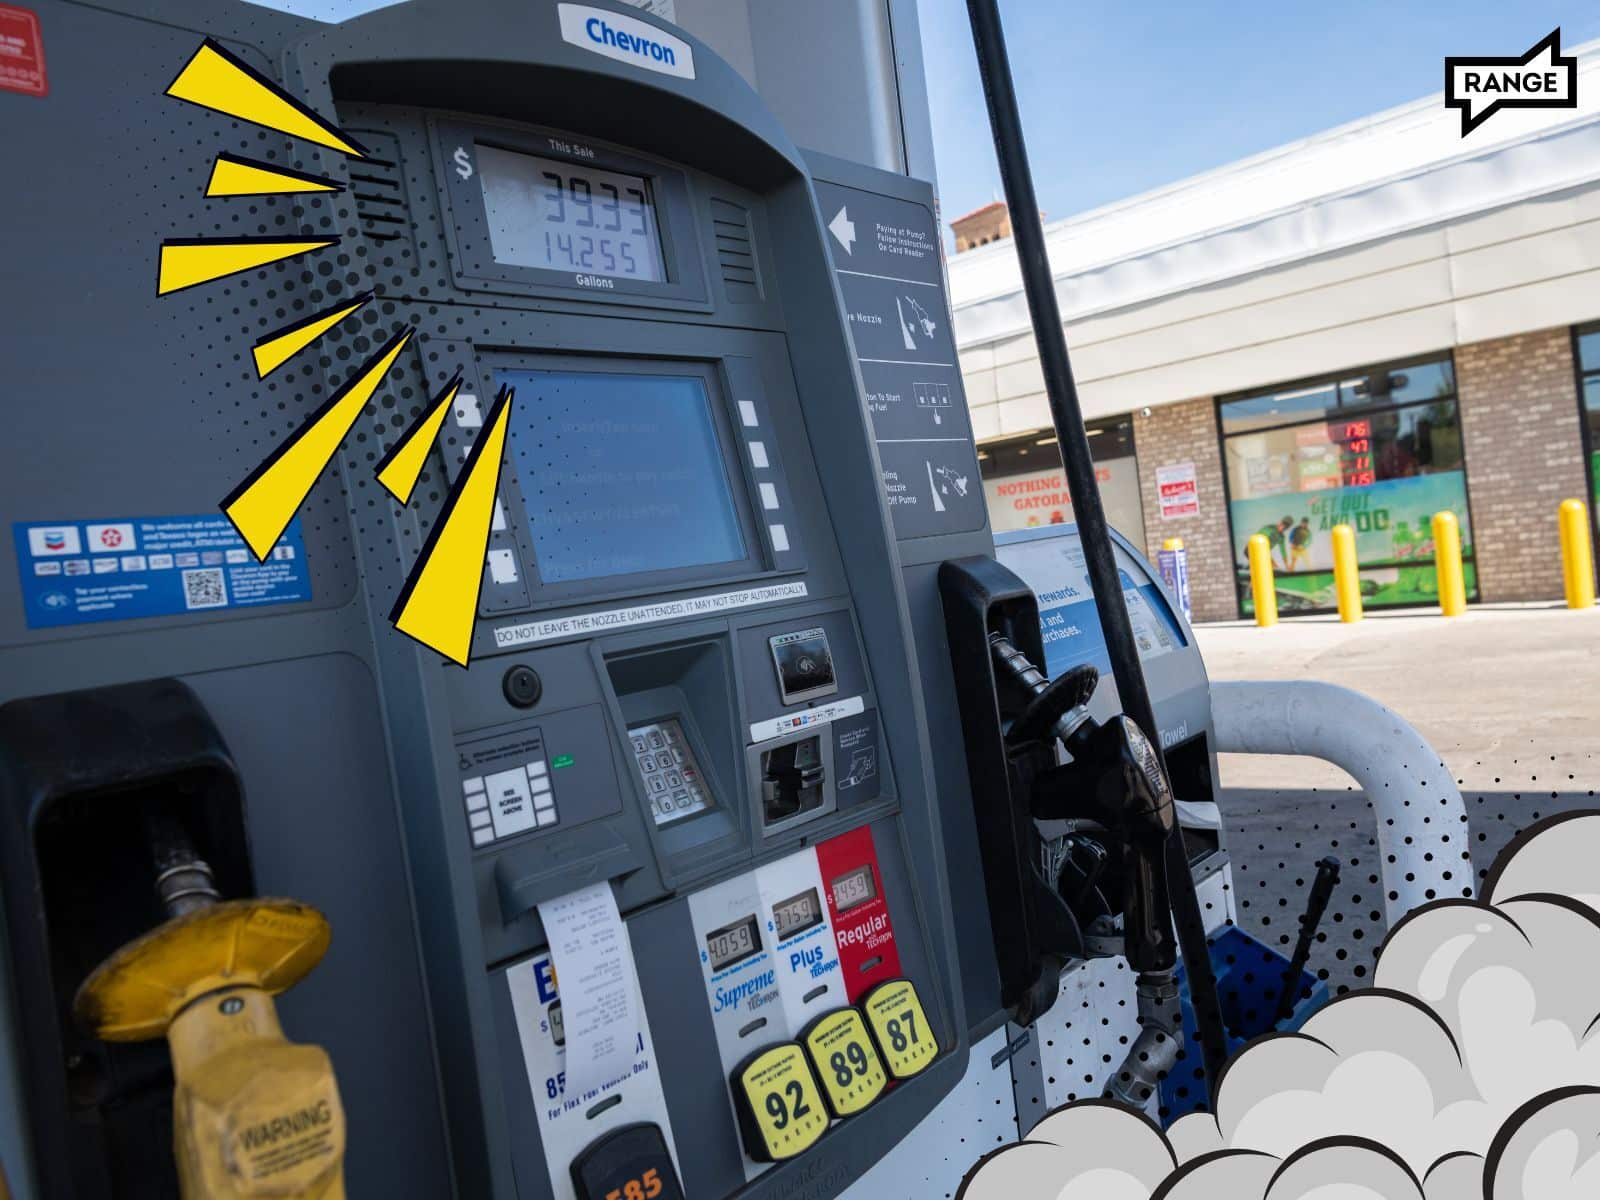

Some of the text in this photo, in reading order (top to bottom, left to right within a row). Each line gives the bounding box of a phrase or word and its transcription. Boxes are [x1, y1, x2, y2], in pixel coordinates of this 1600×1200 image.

[586, 18, 676, 66] Chevron
[454, 147, 473, 180] $
[549, 139, 596, 159] This Sale
[542, 171, 647, 236] 39.33
[544, 231, 636, 274] 14.255
[576, 274, 614, 289] Gallons
[996, 476, 1061, 496] NOTHING
[1014, 492, 1072, 510] GATORA
[1038, 586, 1080, 604] rewards.
[496, 630, 514, 642] DO
[514, 626, 536, 640] NOT
[538, 622, 570, 636] LEAVE
[571, 618, 590, 630] THE
[591, 612, 627, 628] NOZZLE
[686, 602, 694, 611] IT
[694, 599, 714, 610] MAY
[714, 597, 728, 607] NOT
[730, 593, 749, 604] STOP
[750, 585, 806, 600] AUTOMATICALLY
[1047, 612, 1064, 626] and
[1159, 720, 1188, 746] Towel
[827, 894, 833, 904] $
[768, 920, 774, 932] $
[836, 912, 887, 950] Regular
[700, 950, 708, 963] $
[790, 946, 824, 974] Plus
[714, 969, 775, 1012] Supreme
[886, 1008, 920, 1053] 87
[830, 1041, 868, 1088] 89
[548, 1108, 560, 1121] For
[564, 1098, 580, 1112] Flex
[633, 1060, 649, 1075] Only
[766, 1080, 811, 1130] 92
[240, 1098, 332, 1152] WARNING
